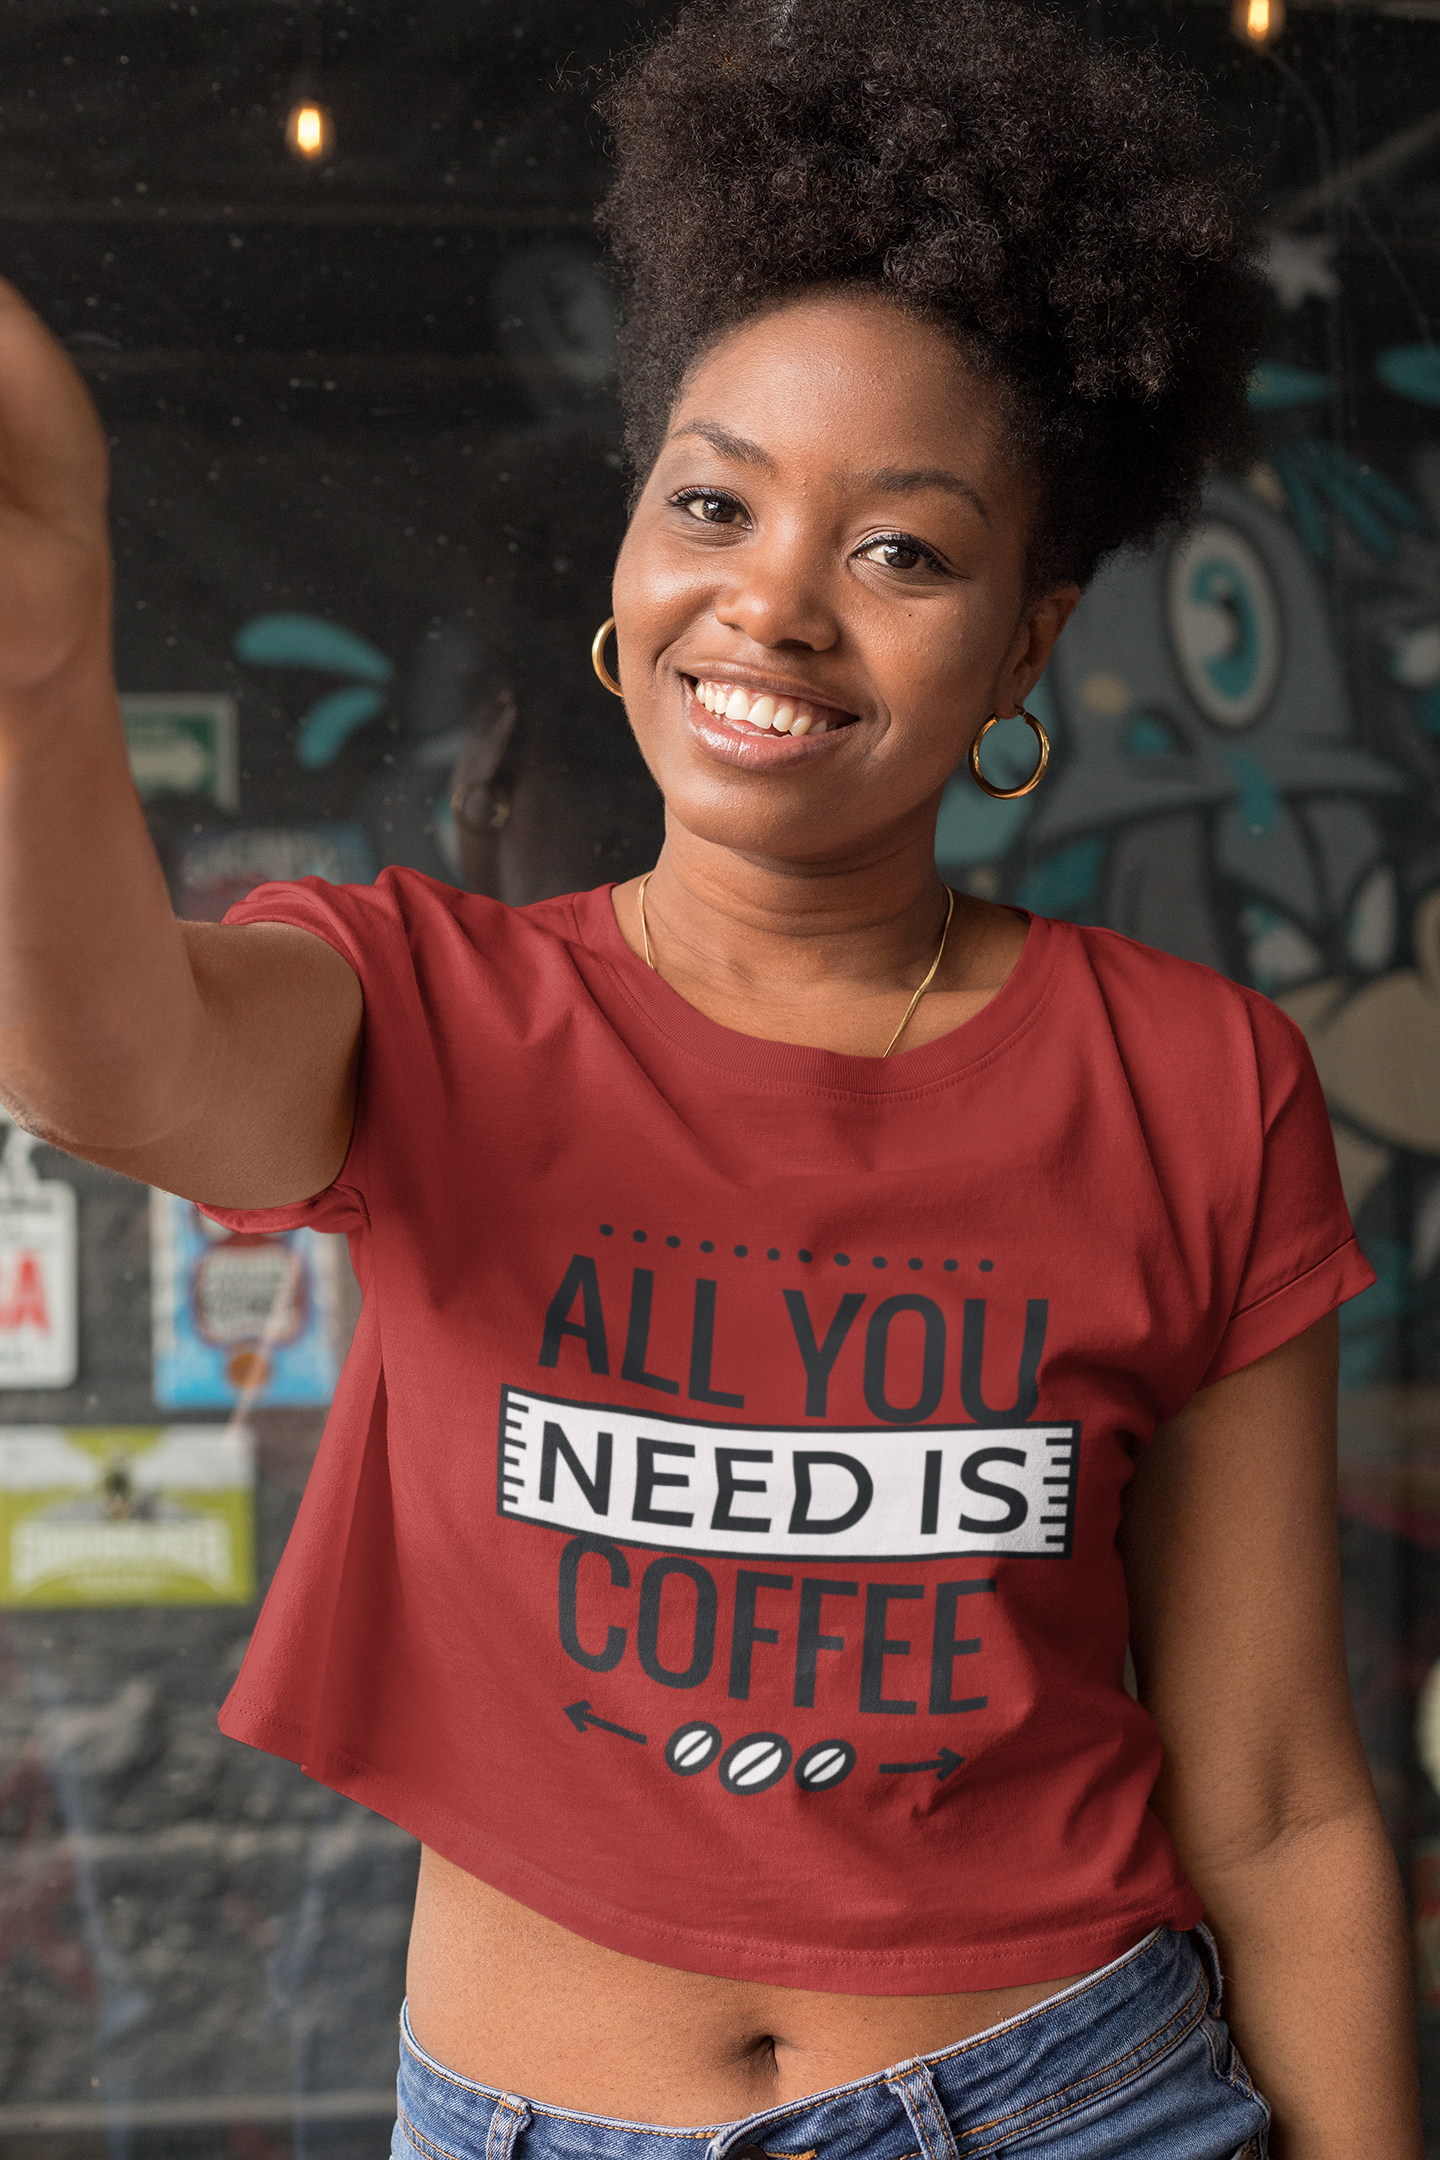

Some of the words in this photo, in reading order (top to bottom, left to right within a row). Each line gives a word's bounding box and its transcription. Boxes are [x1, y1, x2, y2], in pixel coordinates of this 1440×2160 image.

[538, 1254, 745, 1409] ALL
[782, 1289, 1049, 1425] YOU
[538, 1421, 874, 1535] NEED
[920, 1447, 1029, 1535] IS
[558, 1535, 997, 1715] COFFEE
